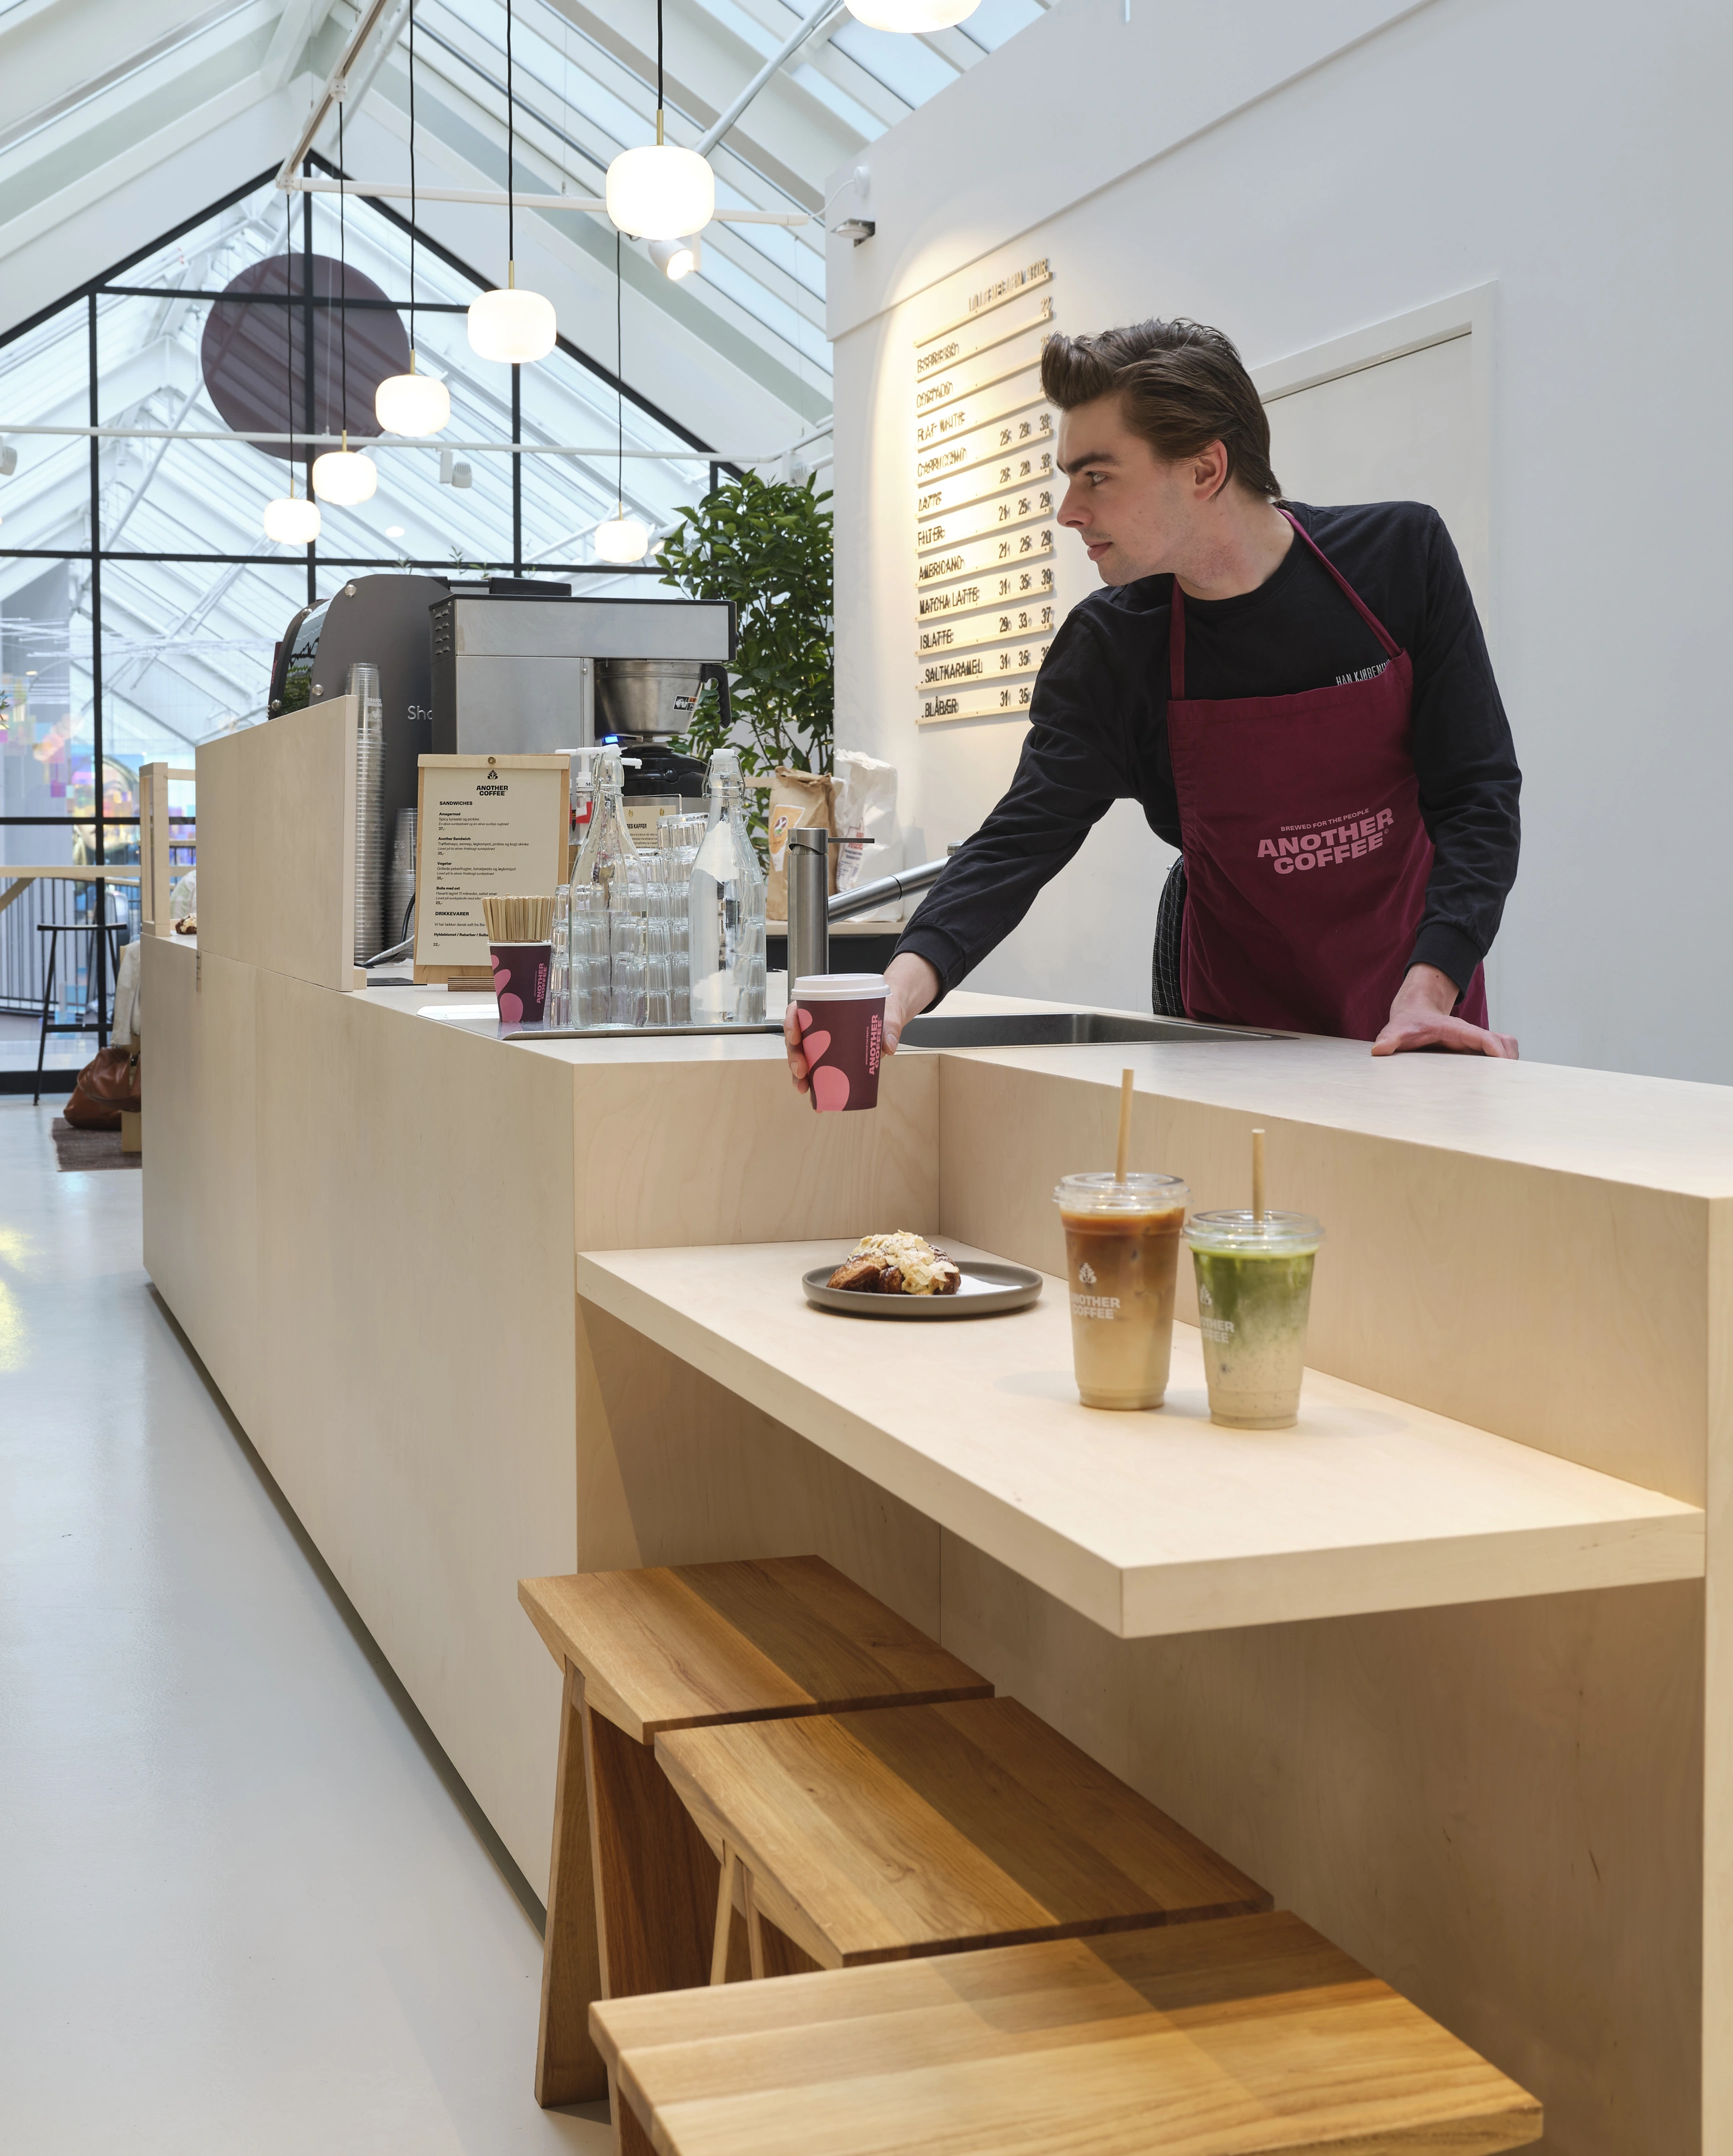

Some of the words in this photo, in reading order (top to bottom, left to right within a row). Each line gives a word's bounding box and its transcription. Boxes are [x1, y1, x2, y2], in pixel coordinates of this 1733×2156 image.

[1027, 258, 1048, 281] STOR
[917, 342, 956, 373] ESPRESSO
[1040, 296, 1050, 313] 22
[916, 381, 950, 408] CORTADO
[918, 423, 936, 443] FLAT
[939, 411, 964, 433] WHITE
[918, 491, 942, 511] LATTE
[918, 525, 943, 546] FILTER
[998, 505, 1007, 521] 21
[1018, 498, 1027, 515] 25
[1040, 491, 1049, 509] 29
[919, 555, 962, 581] AMERICANO
[998, 542, 1007, 558] 21
[1019, 535, 1029, 553] 25
[1040, 530, 1050, 547] 29
[920, 594, 950, 615] MATCHA
[952, 586, 978, 606] LATTE
[999, 578, 1007, 596] 31
[1019, 574, 1028, 590] 35
[1041, 568, 1051, 585] 39
[920, 629, 952, 650] ISLATTE
[999, 616, 1008, 633] 29
[1018, 612, 1027, 628] 33
[1041, 606, 1051, 624] 37
[925, 658, 982, 683] SALTKARAMEL
[1000, 653, 1008, 670] 31
[1018, 650, 1028, 666] 35
[1336, 673, 1353, 686] HAN
[924, 696, 957, 718] BLÅBÆR
[1000, 690, 1008, 706] 31
[1019, 688, 1028, 704] 35
[1343, 808, 1369, 820] PEOPLE
[1257, 808, 1394, 858] ANOTHER
[1274, 832, 1383, 874] COFFEE
[869, 1014, 878, 1075] ANOTHER
